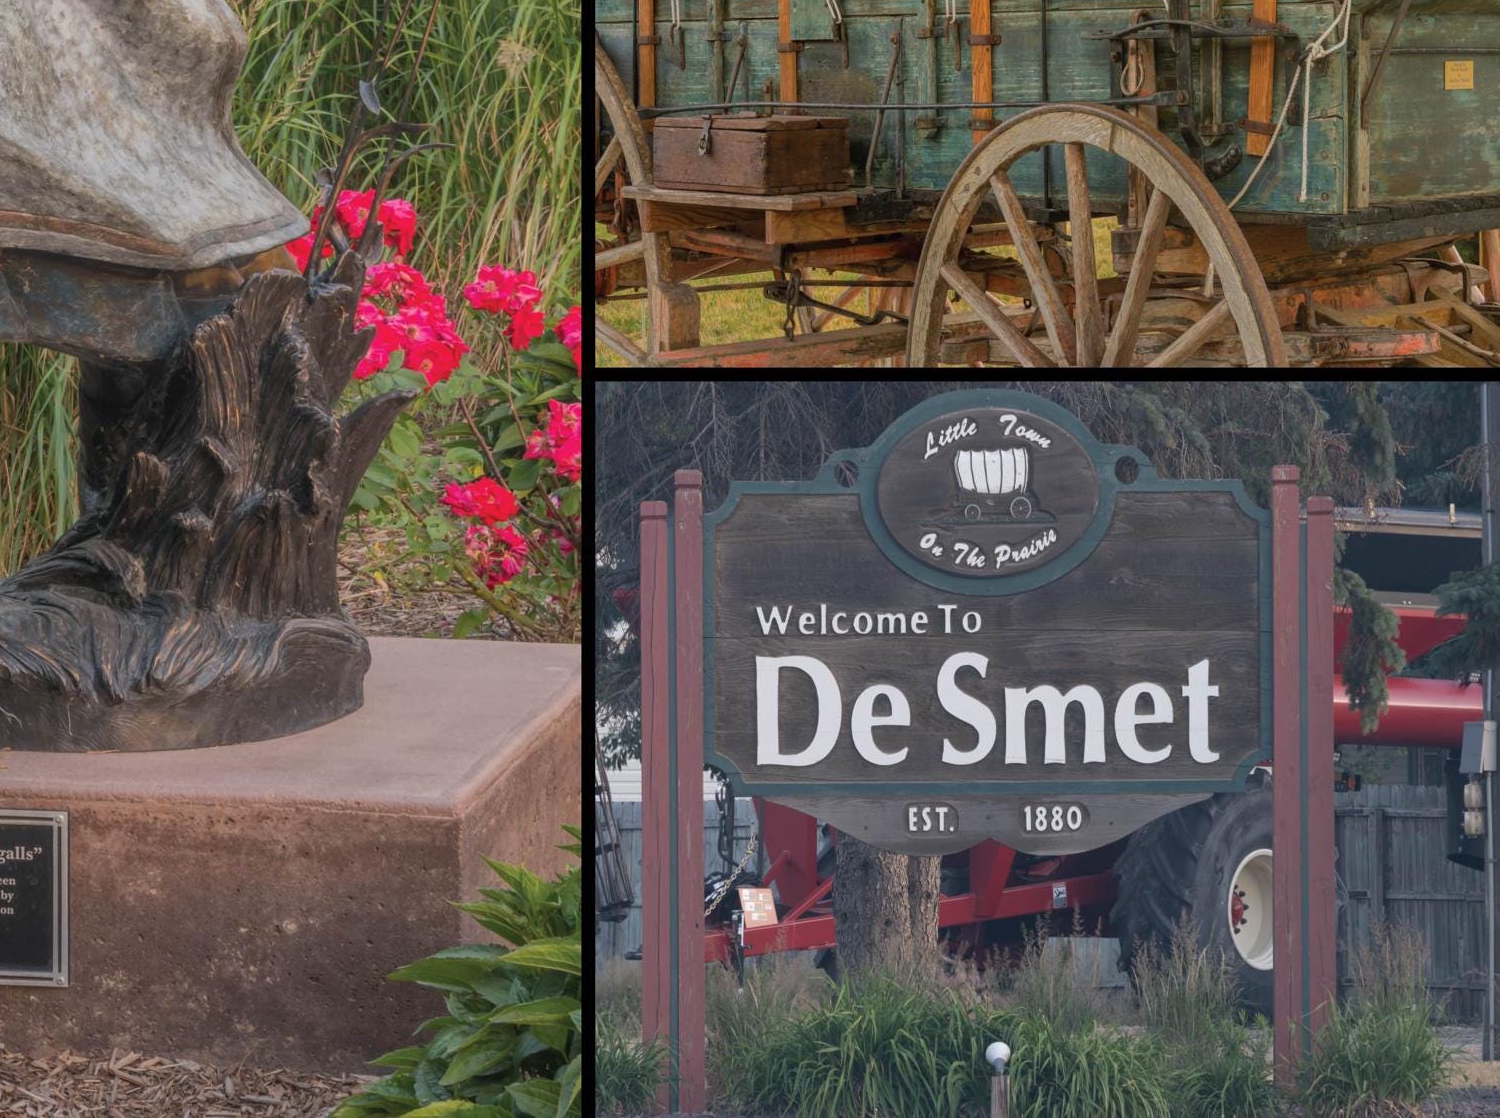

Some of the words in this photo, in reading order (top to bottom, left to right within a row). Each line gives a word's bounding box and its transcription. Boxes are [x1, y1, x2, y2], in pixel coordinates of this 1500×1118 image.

[924, 418, 977, 460] Little
[1000, 414, 1051, 449] Town
[920, 533, 944, 557] On
[953, 542, 986, 568] The
[994, 529, 1057, 570] Prairie
[756, 604, 928, 635] Welcome
[937, 604, 982, 635] To
[755, 654, 911, 767] De
[936, 651, 1220, 765] Smet
[908, 807, 955, 832] EST.
[1024, 805, 1082, 832] 1880
[1, 890, 14, 902] by
